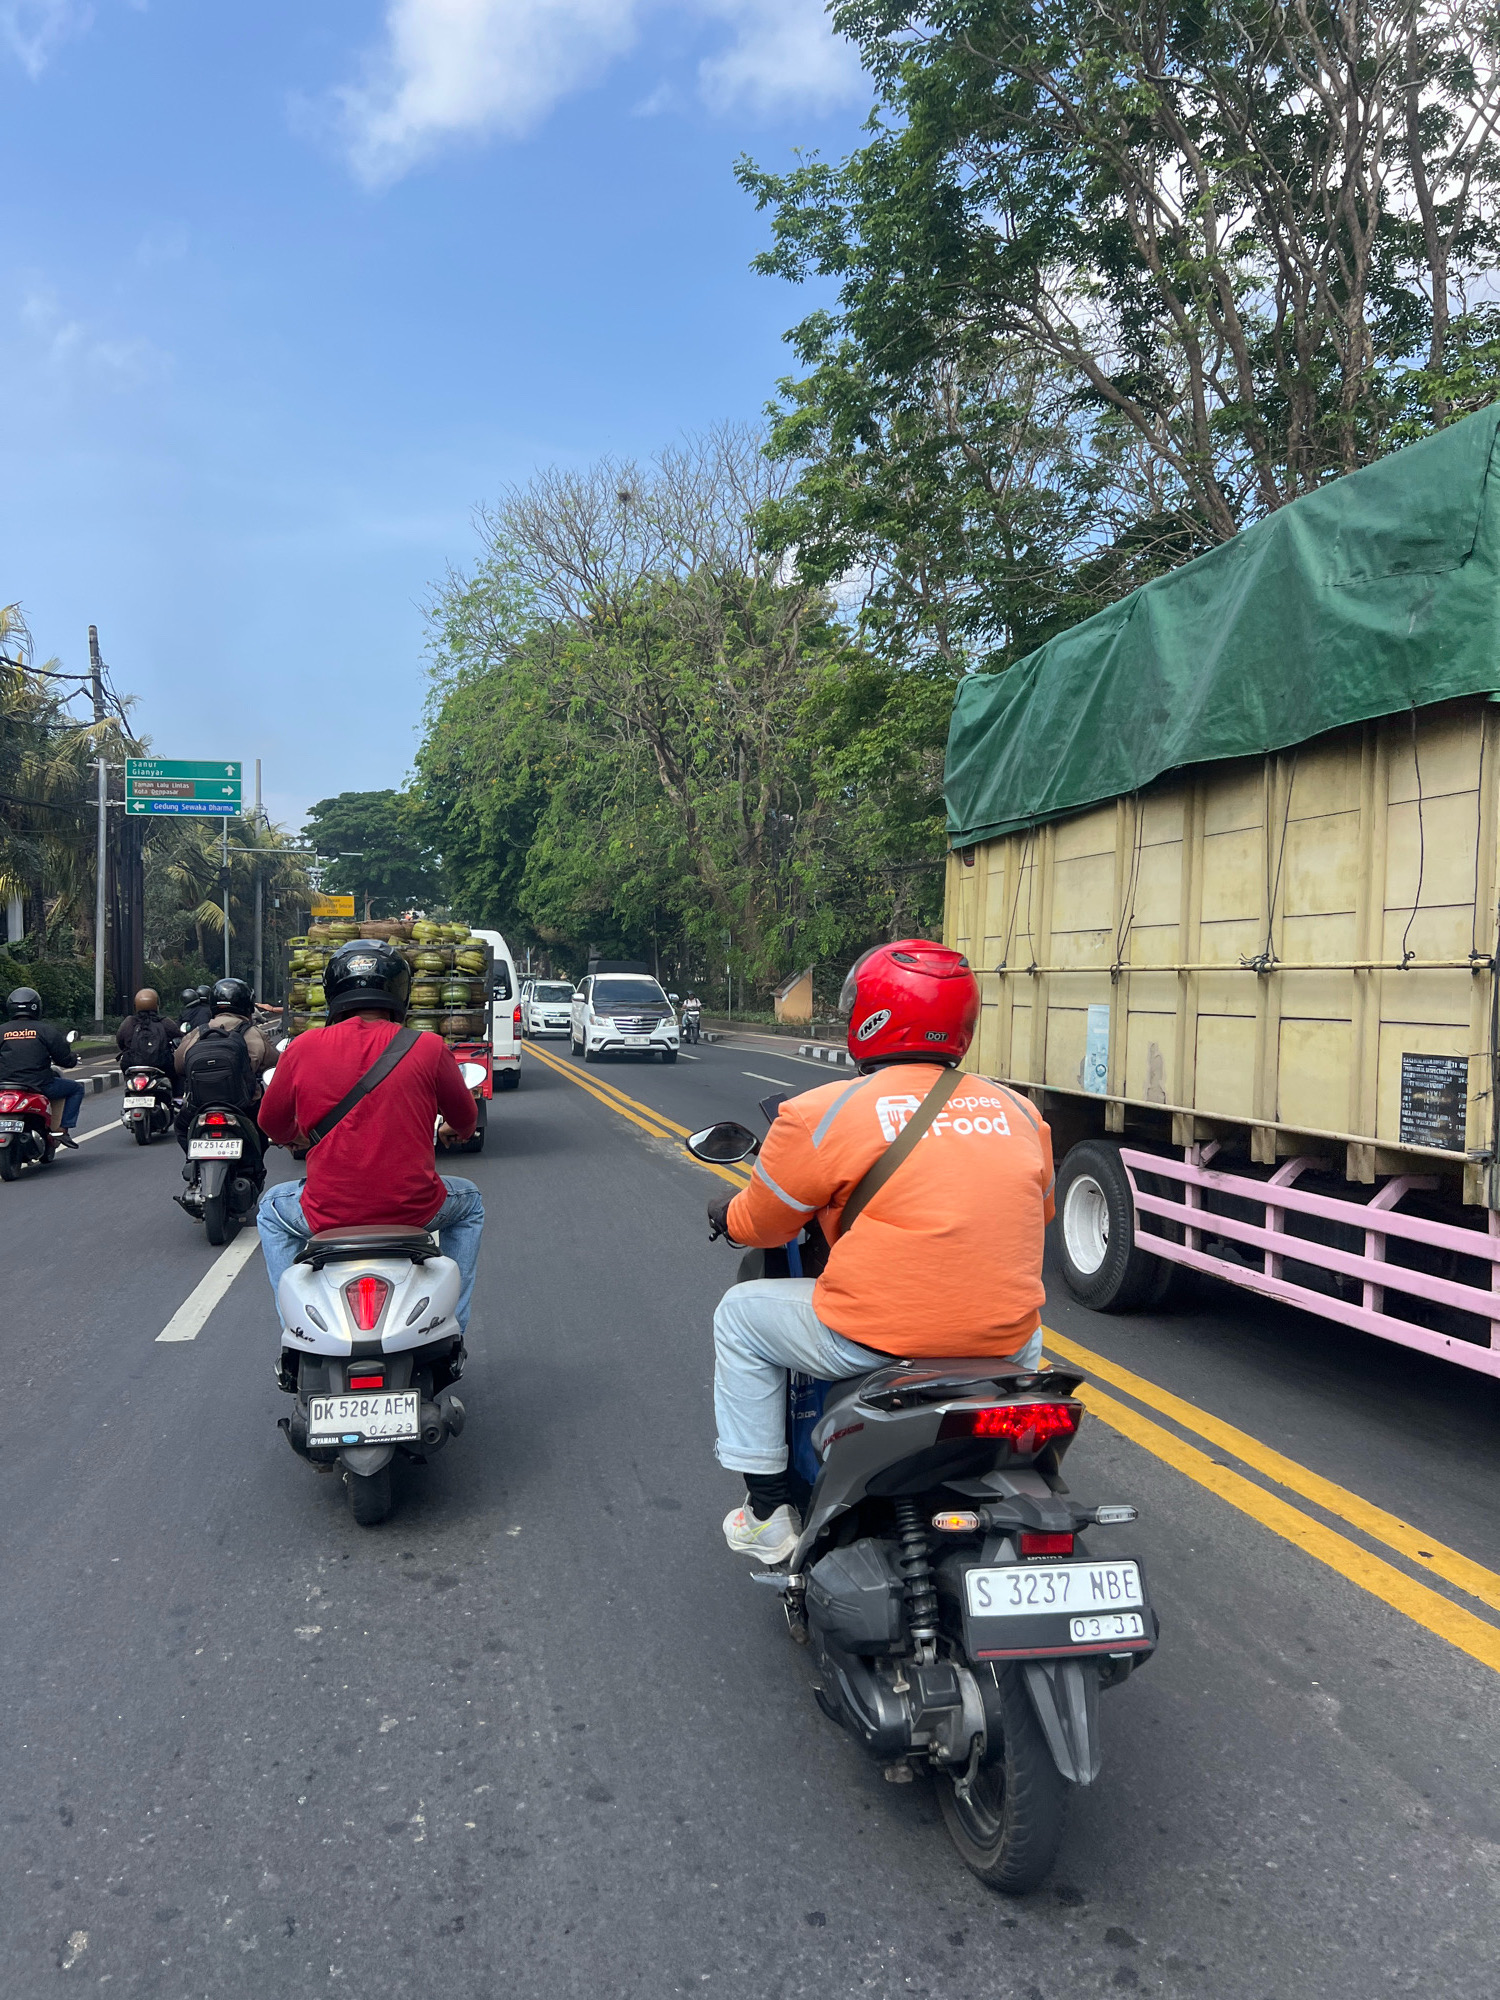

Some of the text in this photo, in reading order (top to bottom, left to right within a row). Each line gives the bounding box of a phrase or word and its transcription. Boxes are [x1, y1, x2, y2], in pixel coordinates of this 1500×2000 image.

[153, 803, 234, 812] Gedung Sewaka Dharma
[860, 1012, 884, 1038] INK
[3, 1028, 37, 1038] maxim
[927, 1032, 947, 1041] DOT
[931, 1111, 1011, 1136] Food
[192, 1141, 240, 1149] DK 2514 AET
[314, 1396, 415, 1420] DK 5284 AEM
[316, 1437, 340, 1445] YAMAHA
[976, 1568, 1138, 1608] S 3237 NBE
